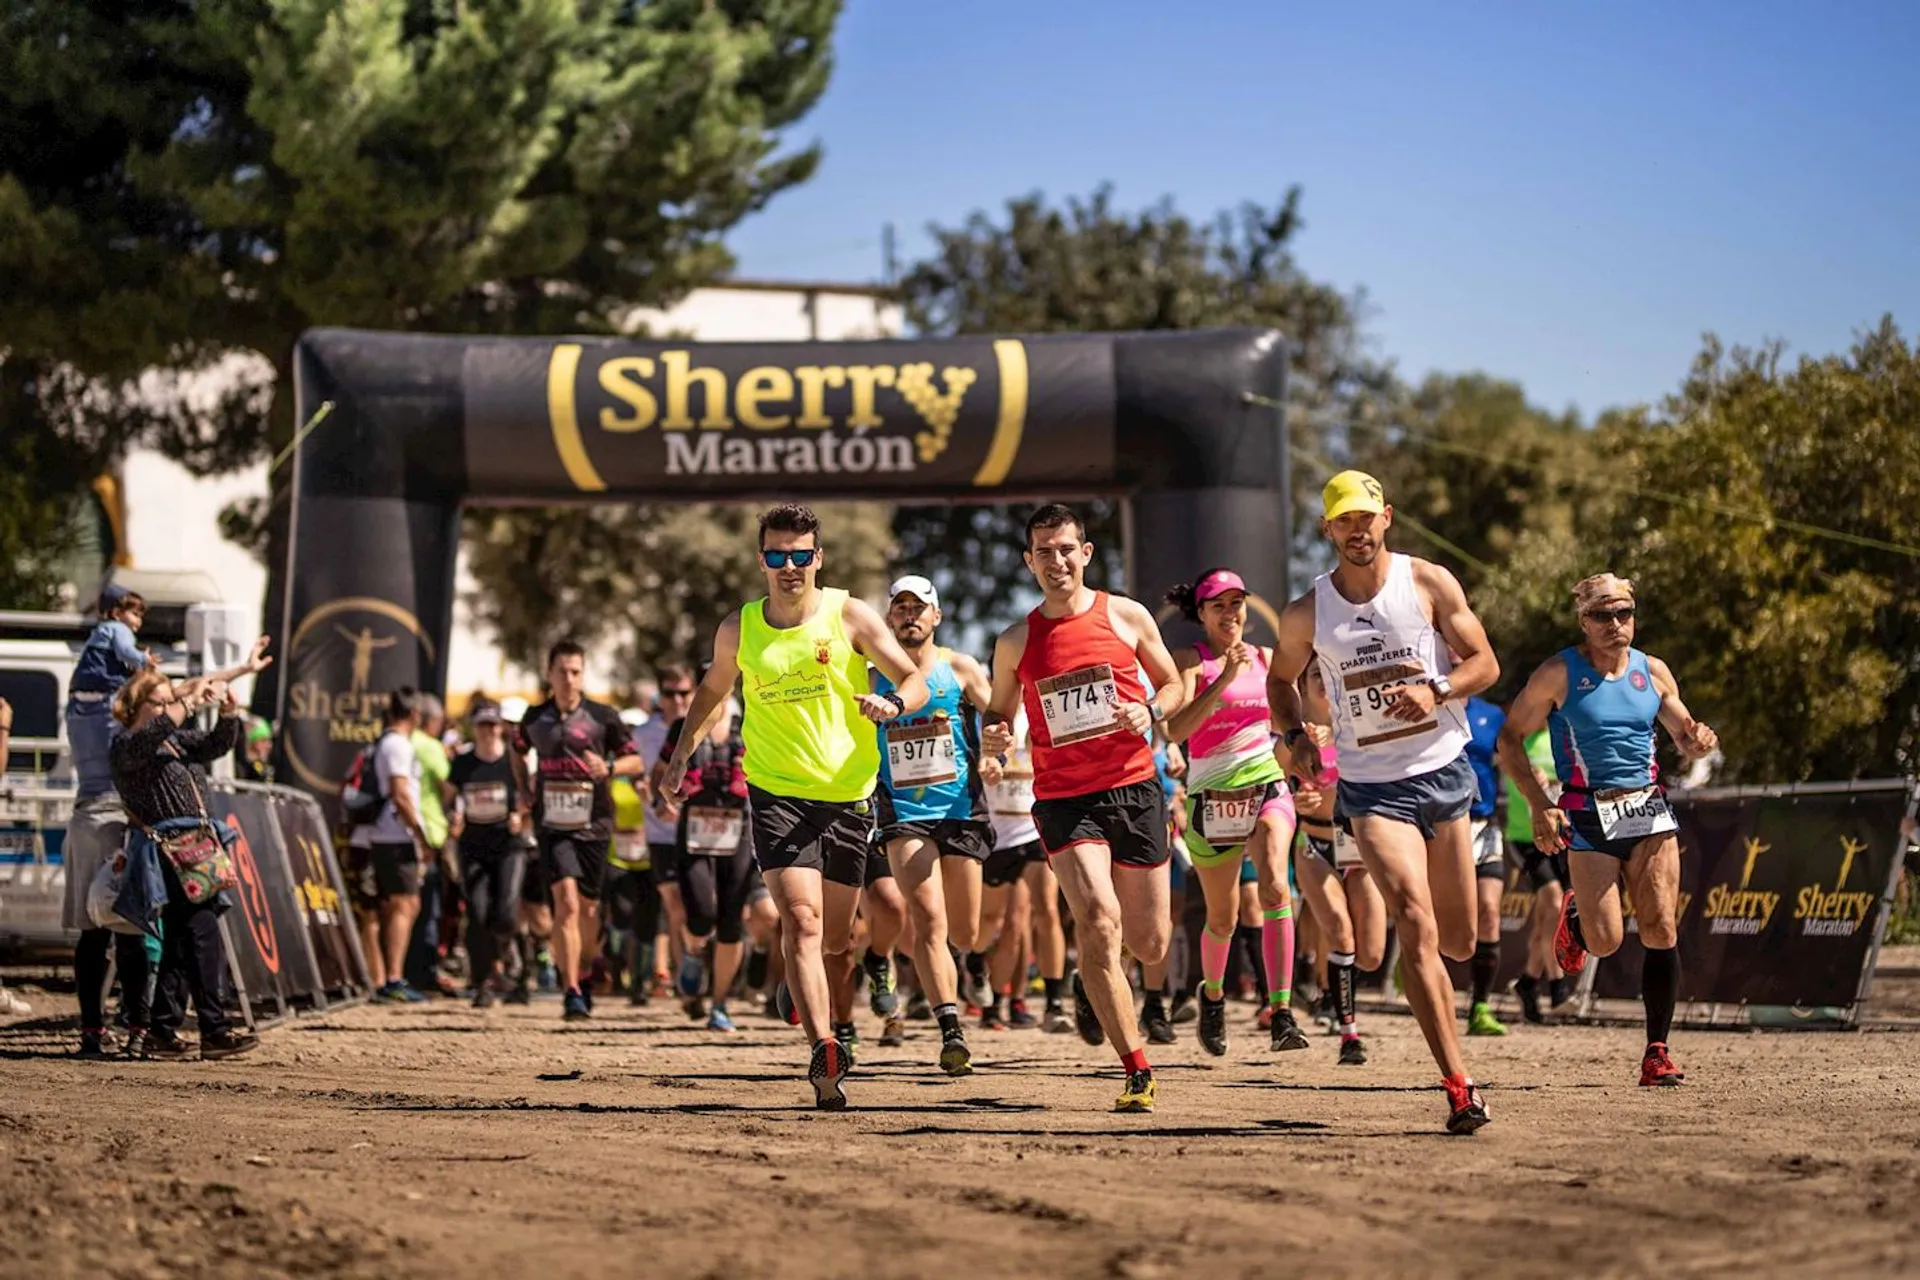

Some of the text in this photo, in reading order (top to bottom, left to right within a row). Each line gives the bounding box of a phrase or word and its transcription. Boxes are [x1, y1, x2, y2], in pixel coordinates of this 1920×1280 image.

[598, 350, 977, 463] Sherry
[664, 425, 916, 475] Maratón
[1340, 646, 1413, 670] CHAPIN JEREZ
[1058, 684, 1098, 712] 774
[904, 738, 935, 760] 977
[1704, 882, 1780, 930] Sherry
[1794, 882, 1875, 931] Sherry
